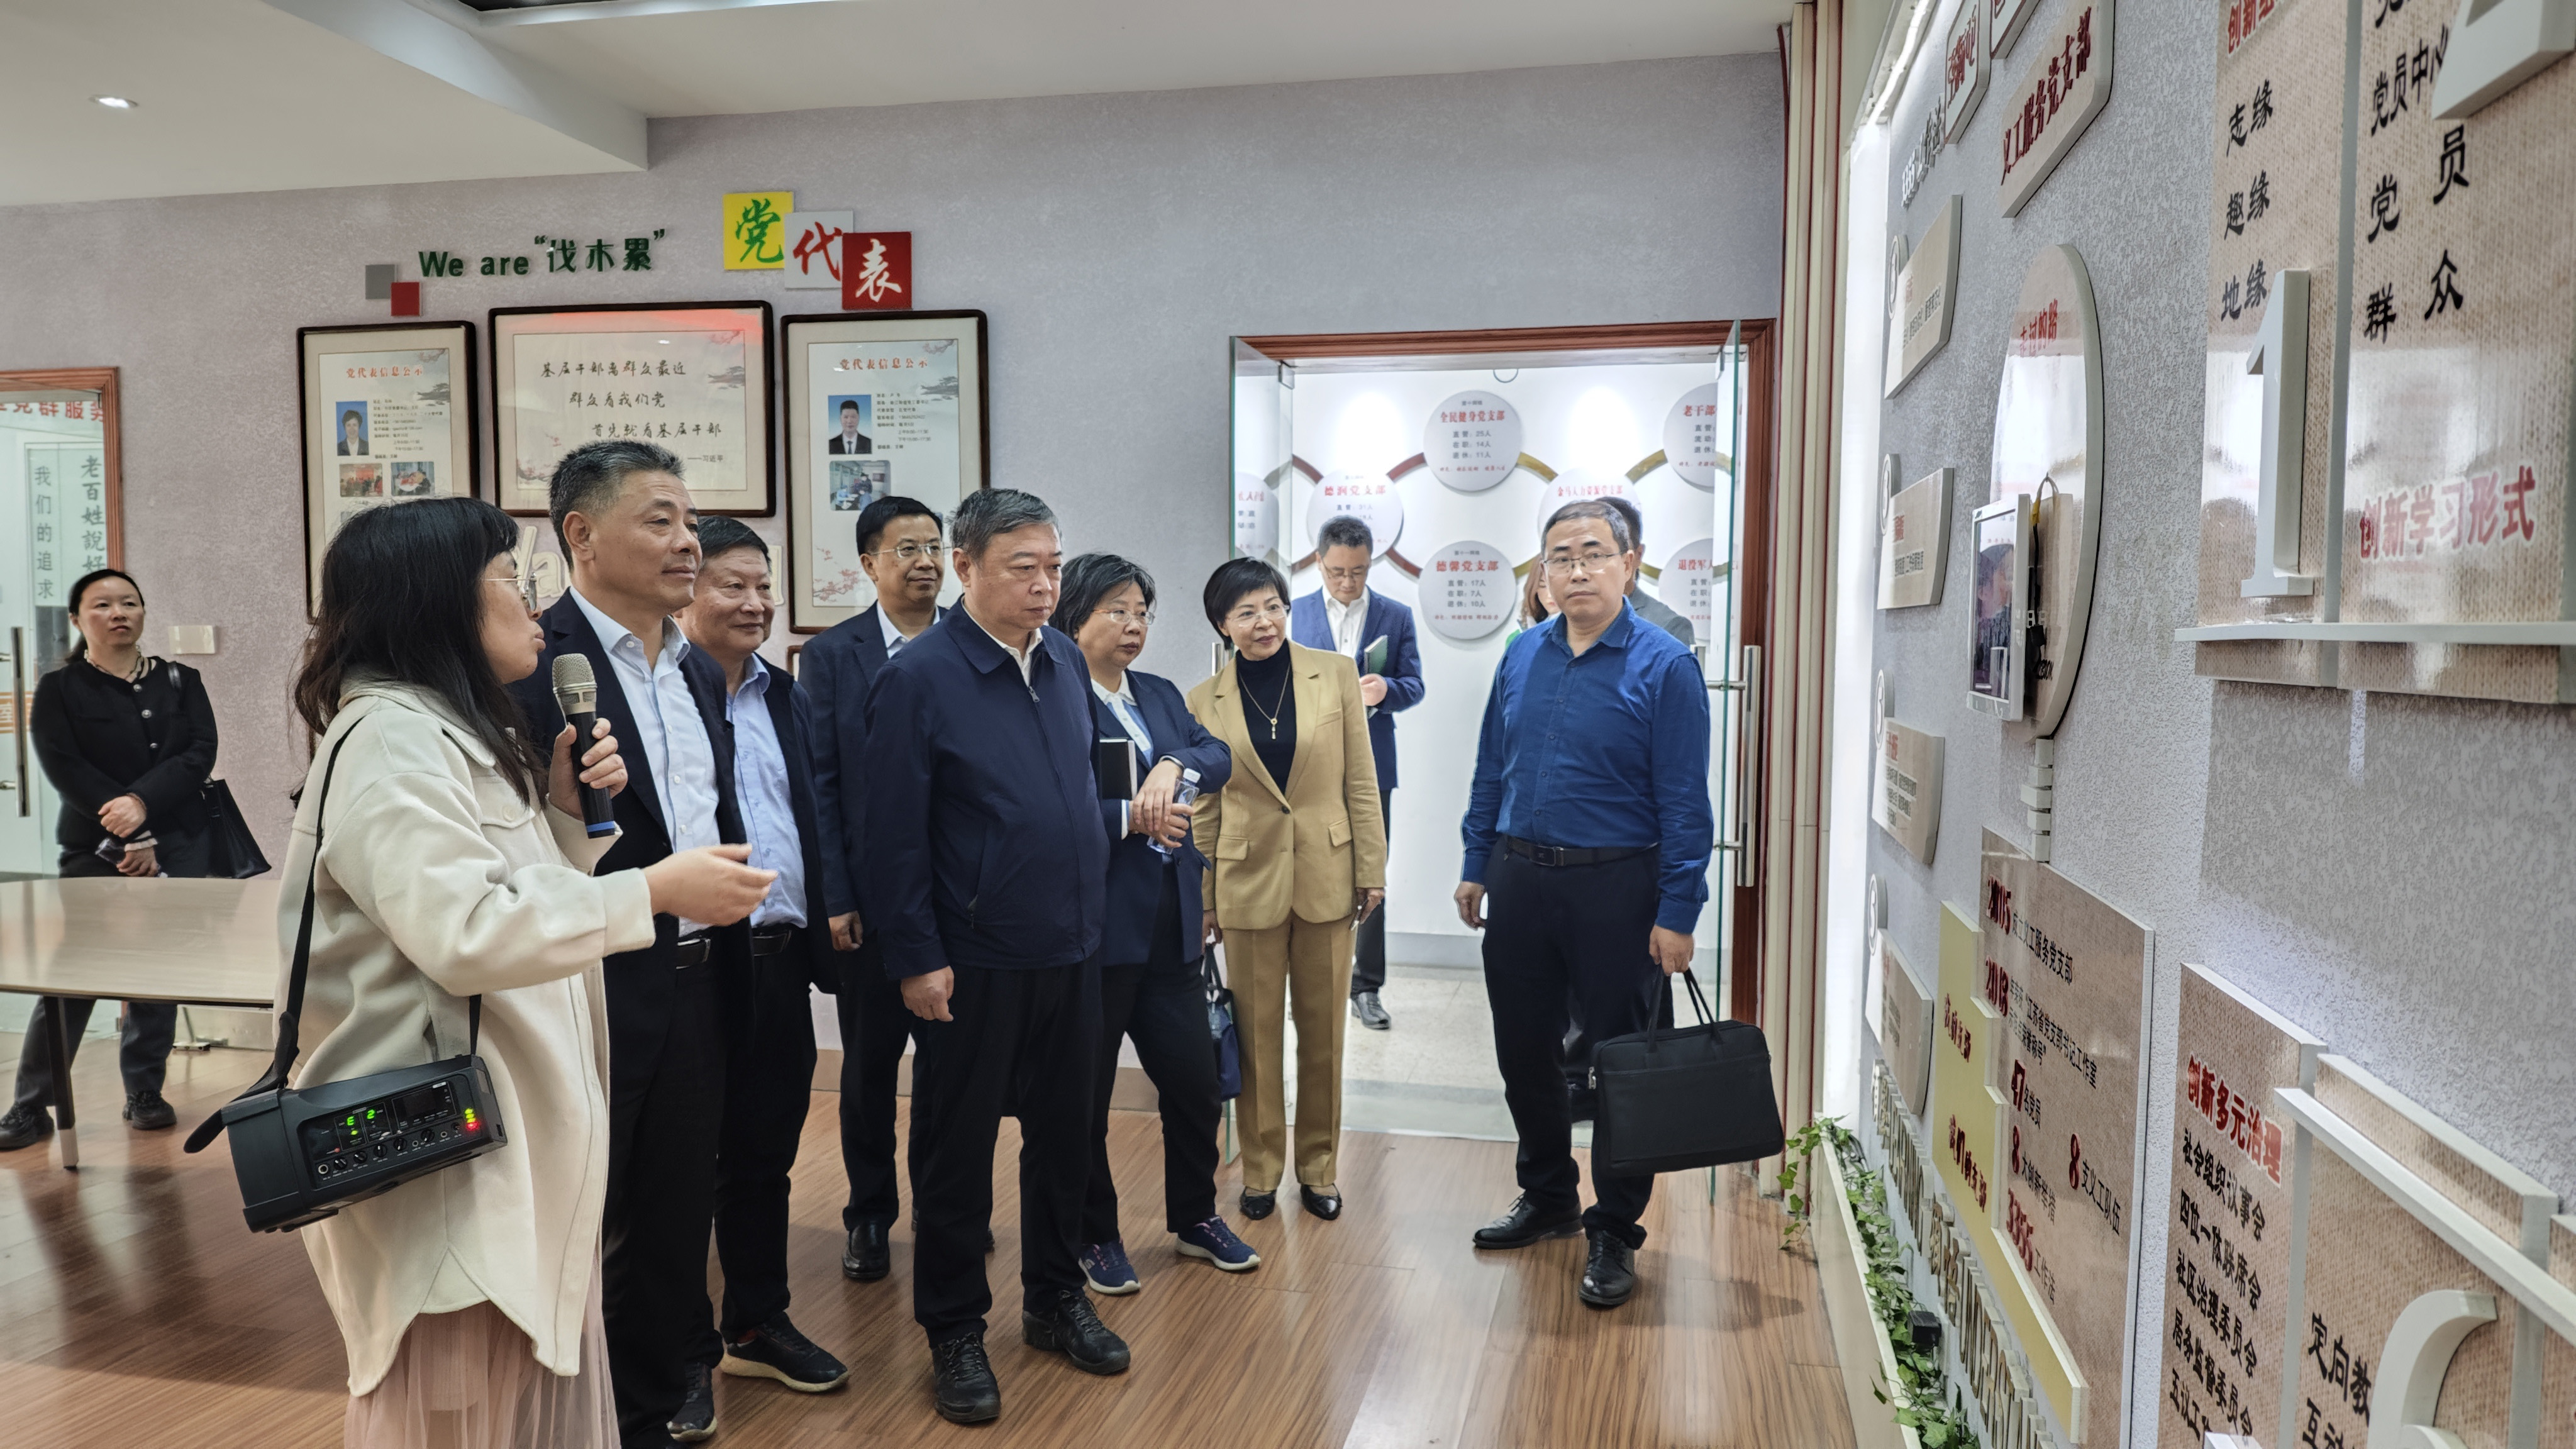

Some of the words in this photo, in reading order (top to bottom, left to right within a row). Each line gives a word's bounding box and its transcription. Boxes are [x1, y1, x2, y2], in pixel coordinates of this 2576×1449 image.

[2228, 0, 2274, 54] 创新
[2001, 6, 2091, 186] 义工服务党支部
[2224, 170, 2270, 240] 趣缘
[419, 251, 464, 277] We
[480, 255, 530, 276] are
[2221, 258, 2267, 323] 地缘
[347, 365, 423, 378] 党代表信息公示
[541, 360, 686, 377] 基层干部离群众最近
[840, 357, 928, 370] 党代表信息公示
[569, 391, 665, 408] 群众看我们党
[592, 422, 722, 438] 首先就看基层干部
[1440, 410, 1505, 423] 全民健身党支部
[35, 465, 54, 600] 我们的追求
[2360, 465, 2536, 559] 创新学习形式
[1987, 874, 2011, 935] 2005
[2012, 912, 2074, 985] 成立义工服务党支部
[367, 1109, 375, 1119] 2
[2024, 1084, 2041, 1130] 名党员
[2187, 1054, 2282, 1184] 创新多元治理
[2012, 1123, 2020, 1175] 8
[2069, 1133, 2080, 1191] 8
[2021, 1151, 2057, 1226] 大创新举措
[2082, 1158, 2121, 1236] 支义工队伍
[2183, 1128, 2265, 1242] 社会组织议事会
[2034, 1248, 2056, 1305] 工作法
[2180, 1188, 2262, 1311] 四位一体联席会
[2176, 1248, 2257, 1379] 社区治理委员会
[2173, 1307, 2253, 1436] 居务监督委员会
[2170, 1367, 2212, 1441] 五议工
